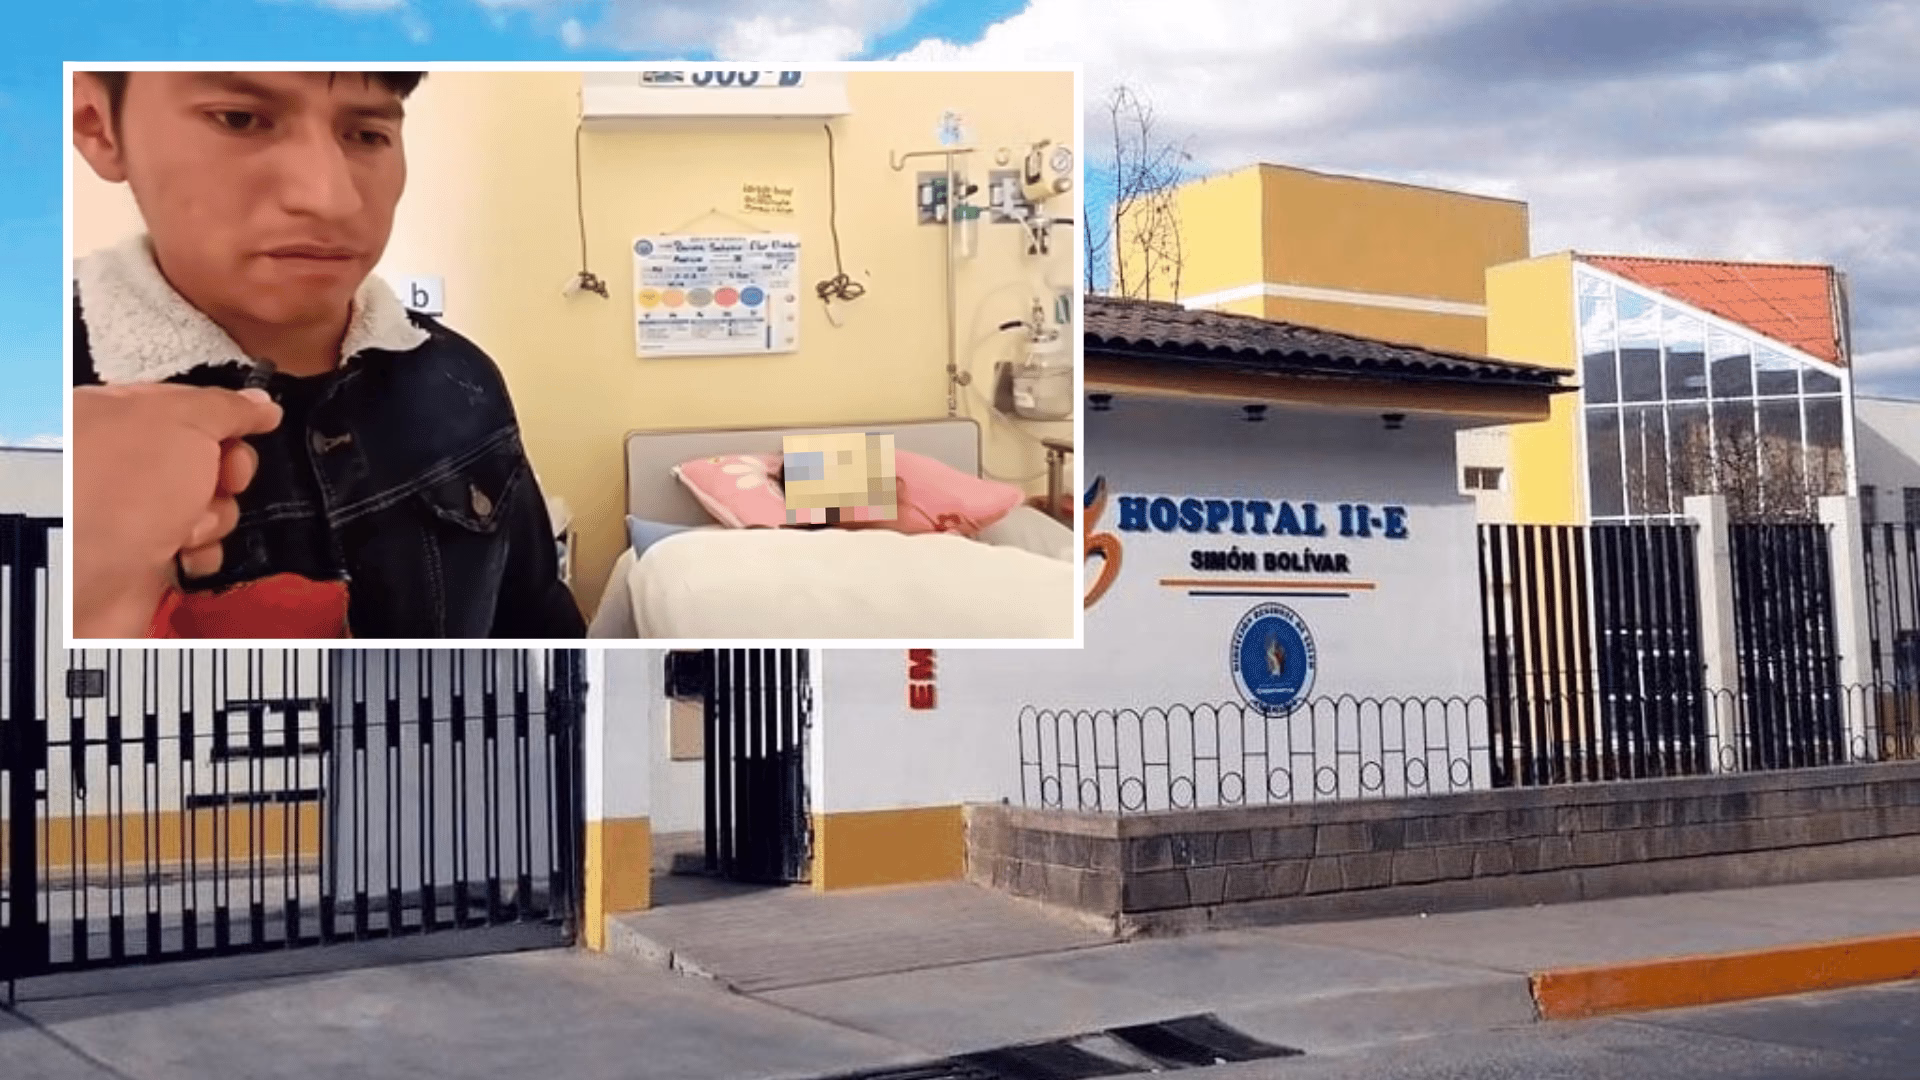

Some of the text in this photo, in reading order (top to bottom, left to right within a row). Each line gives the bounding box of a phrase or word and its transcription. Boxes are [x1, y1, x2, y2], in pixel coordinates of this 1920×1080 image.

[411, 282, 429, 308] b
[1118, 496, 1408, 539] HOSPITAL II-E
[1190, 546, 1350, 573] SIMÓN BOLÍVAR
